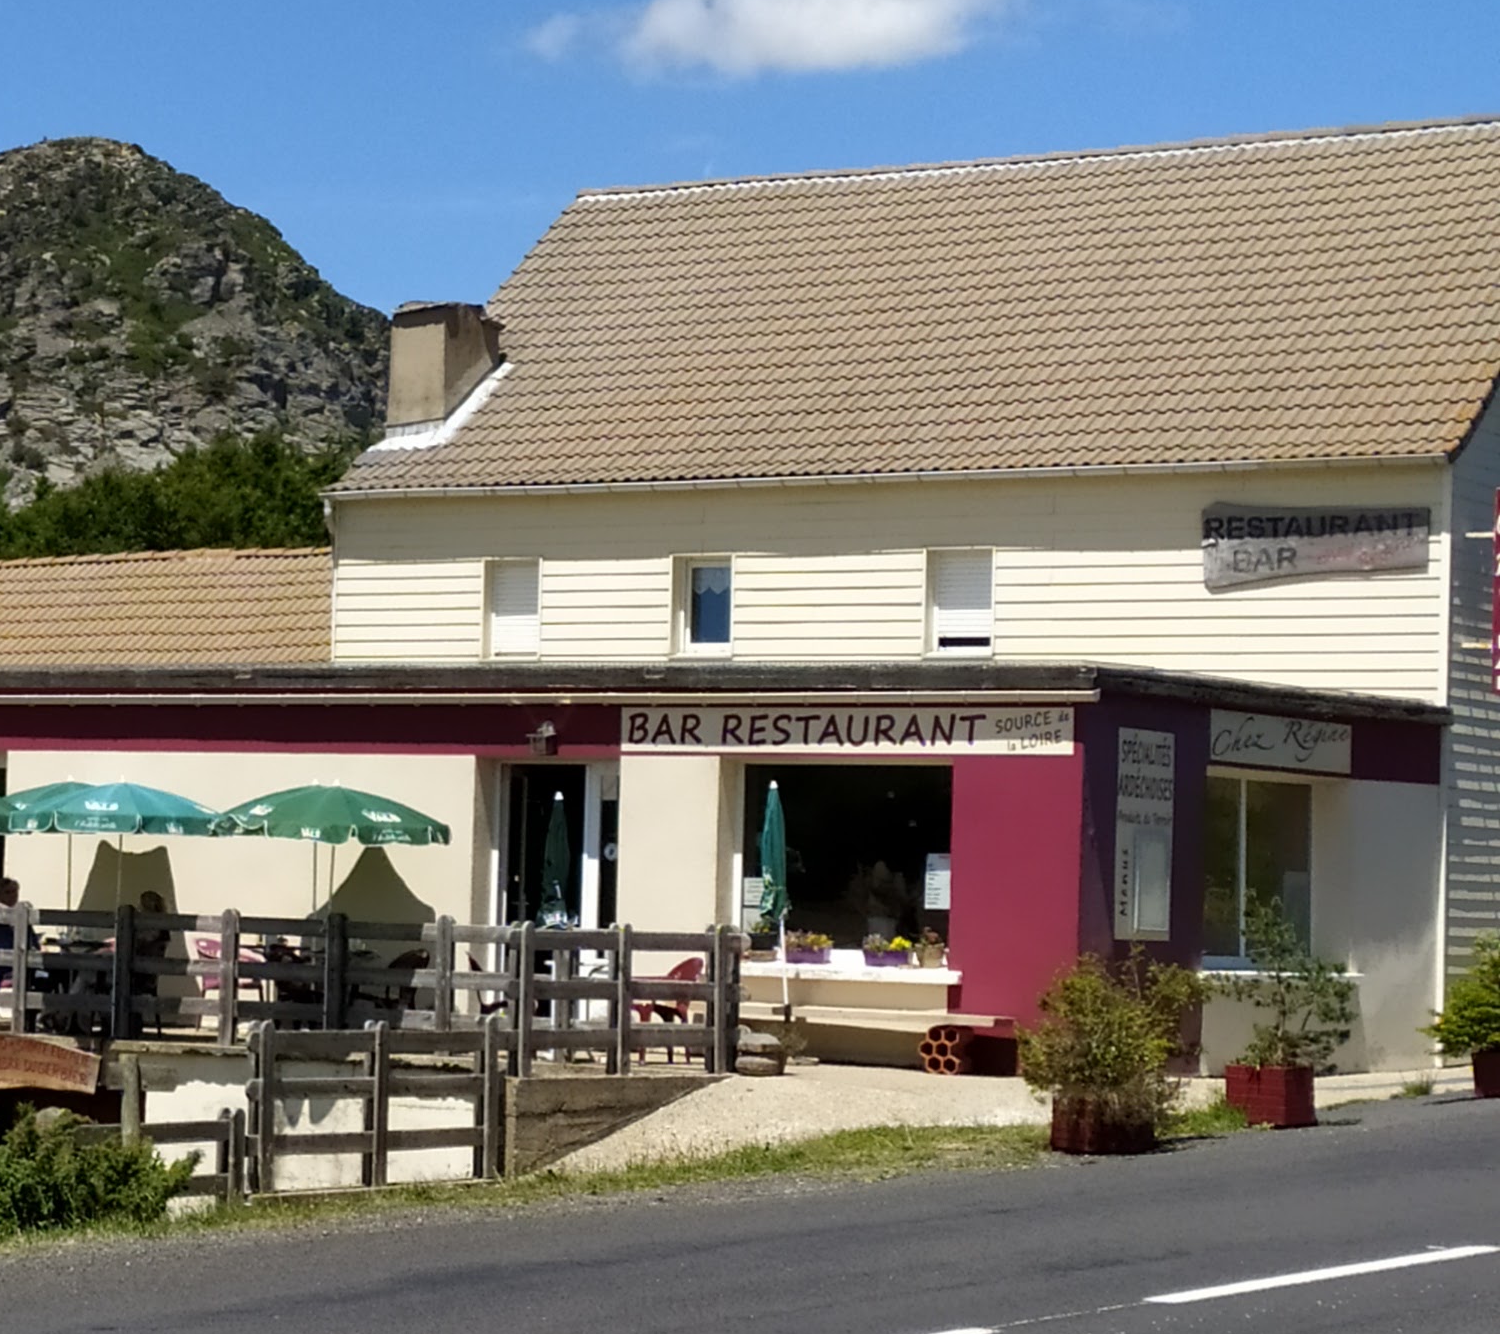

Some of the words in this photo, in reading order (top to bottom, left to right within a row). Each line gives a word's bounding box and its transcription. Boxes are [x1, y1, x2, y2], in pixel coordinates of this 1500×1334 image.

[1204, 513, 1420, 540] RESTAURANT
[1233, 547, 1298, 574] BAR
[627, 712, 702, 745] BAR
[721, 714, 987, 746] RESTAURANT
[995, 711, 1051, 734] SOURCE
[1020, 729, 1063, 751] LOIRE
[1212, 716, 1274, 757] Chez
